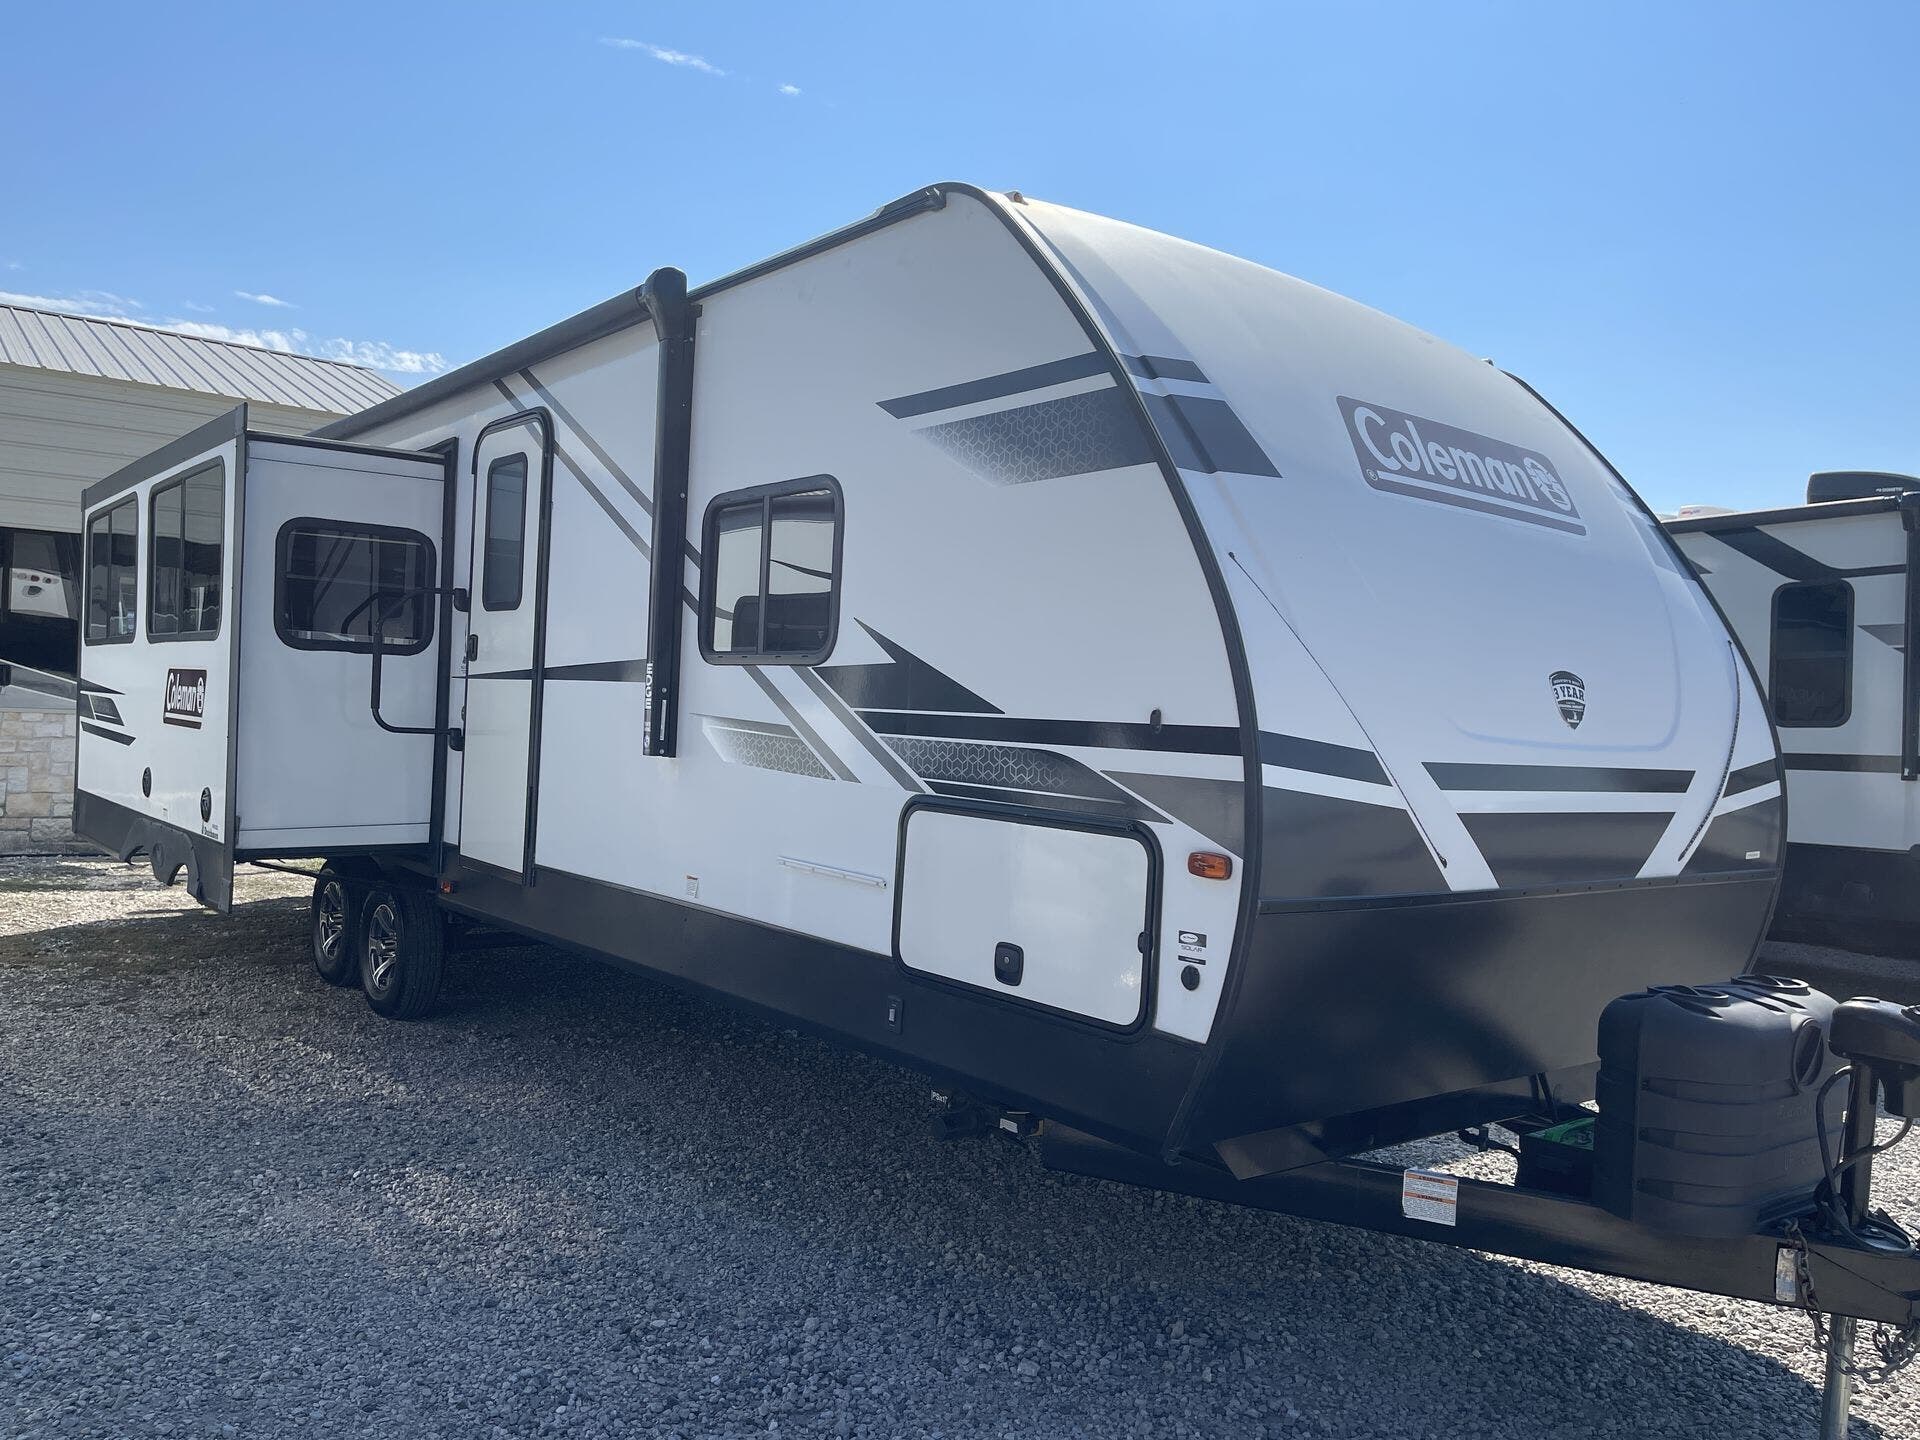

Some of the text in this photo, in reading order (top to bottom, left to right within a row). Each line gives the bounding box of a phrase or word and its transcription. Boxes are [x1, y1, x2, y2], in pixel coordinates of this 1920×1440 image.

[1354, 407, 1538, 501] Coleman
[166, 672, 197, 711] Coleman
[1553, 686, 1584, 701] 3 YEAR
